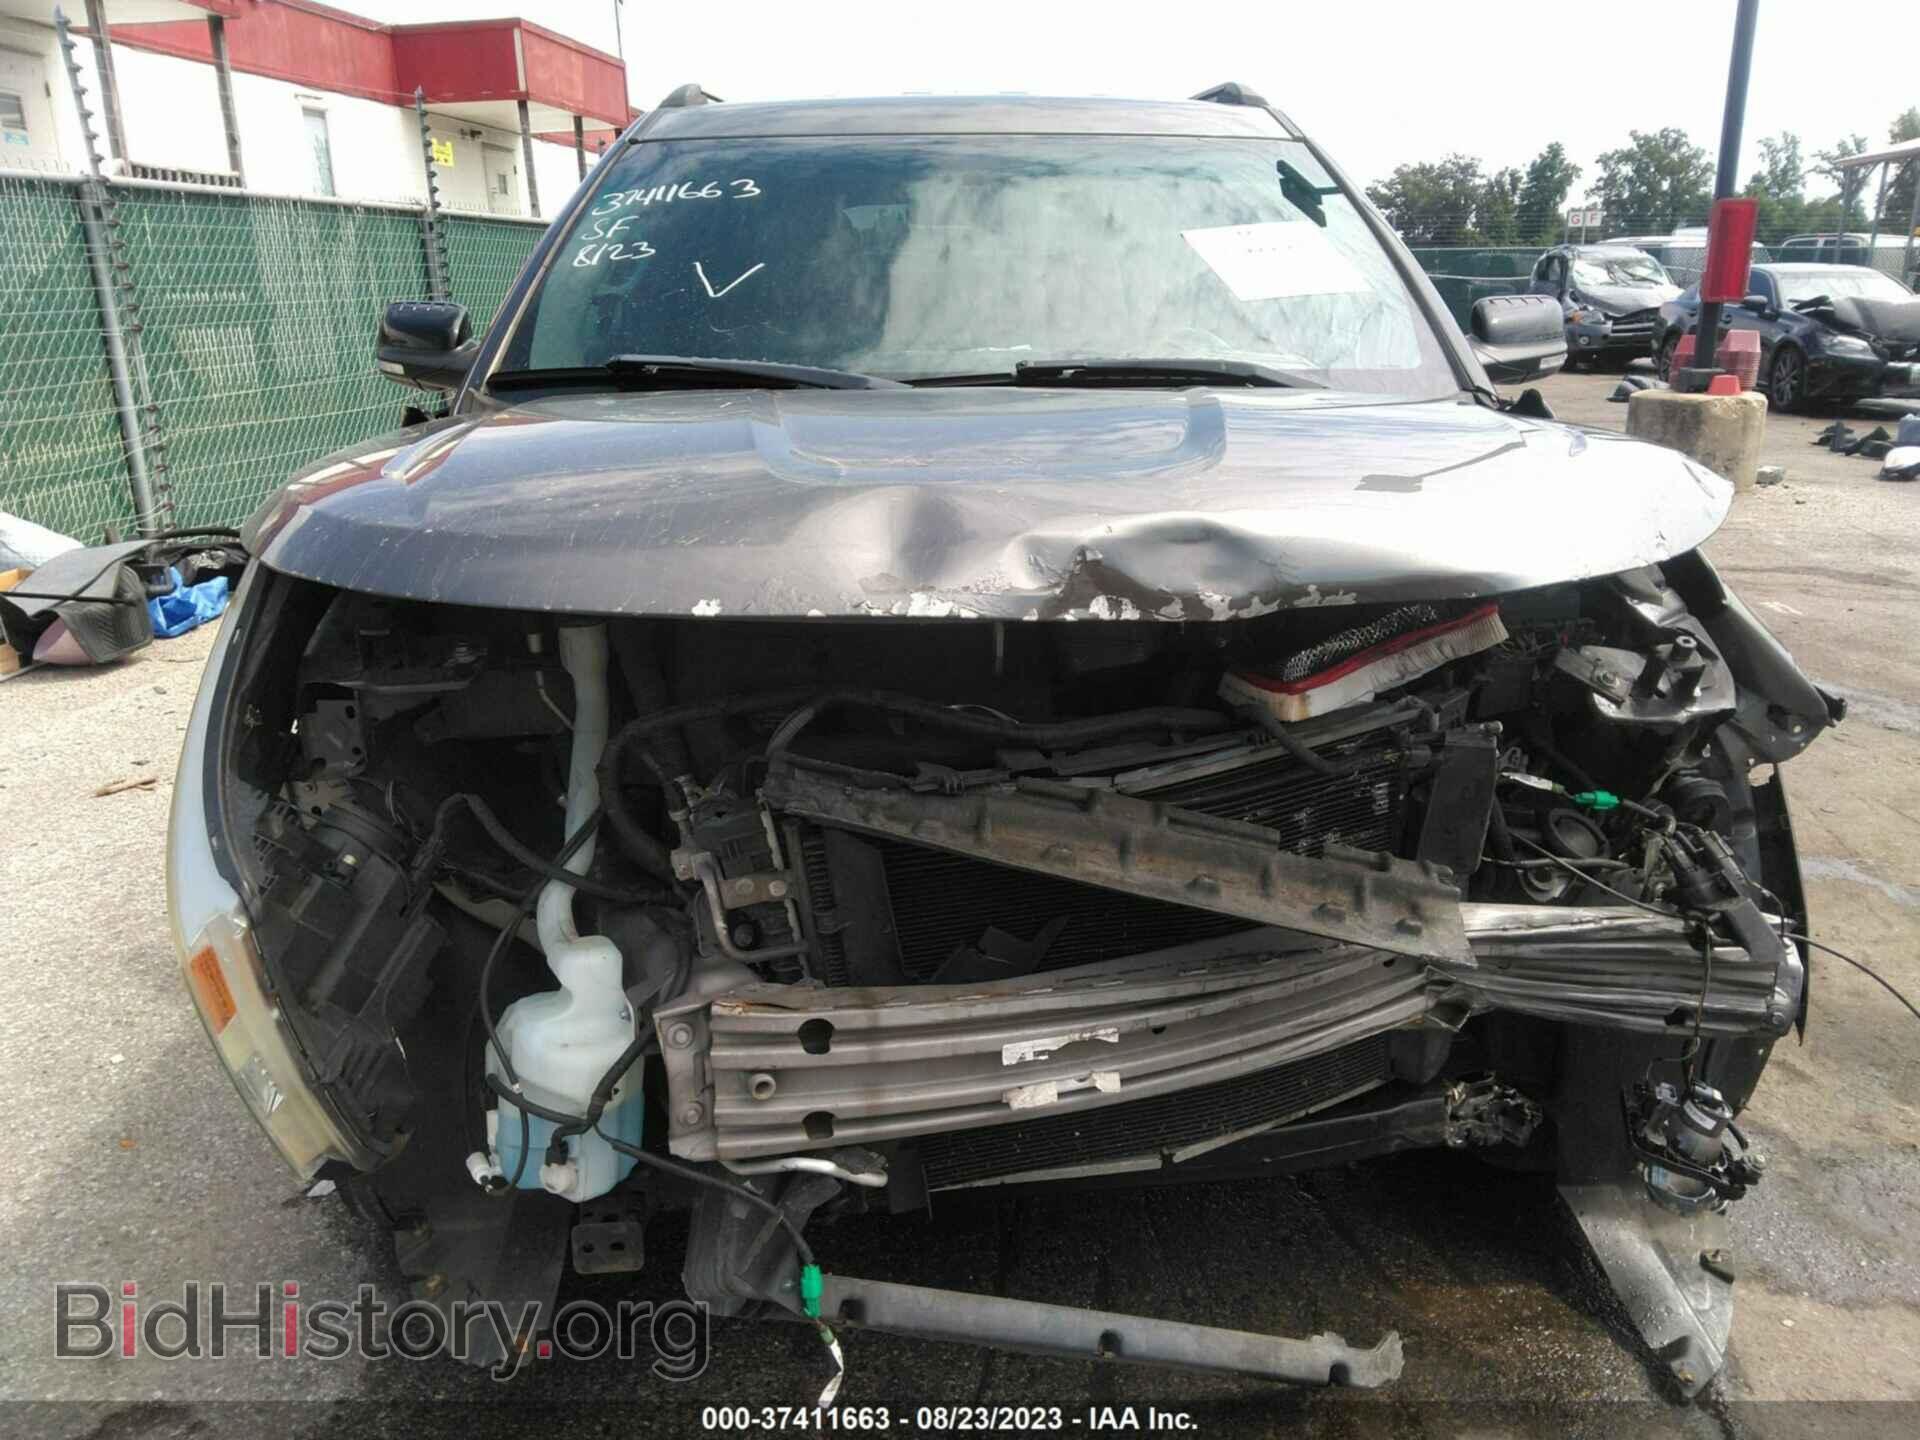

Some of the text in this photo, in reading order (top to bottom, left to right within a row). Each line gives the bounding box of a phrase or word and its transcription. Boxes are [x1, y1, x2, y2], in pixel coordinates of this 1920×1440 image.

[591, 178, 761, 216] 37411663
[1571, 213, 1598, 225] G F
